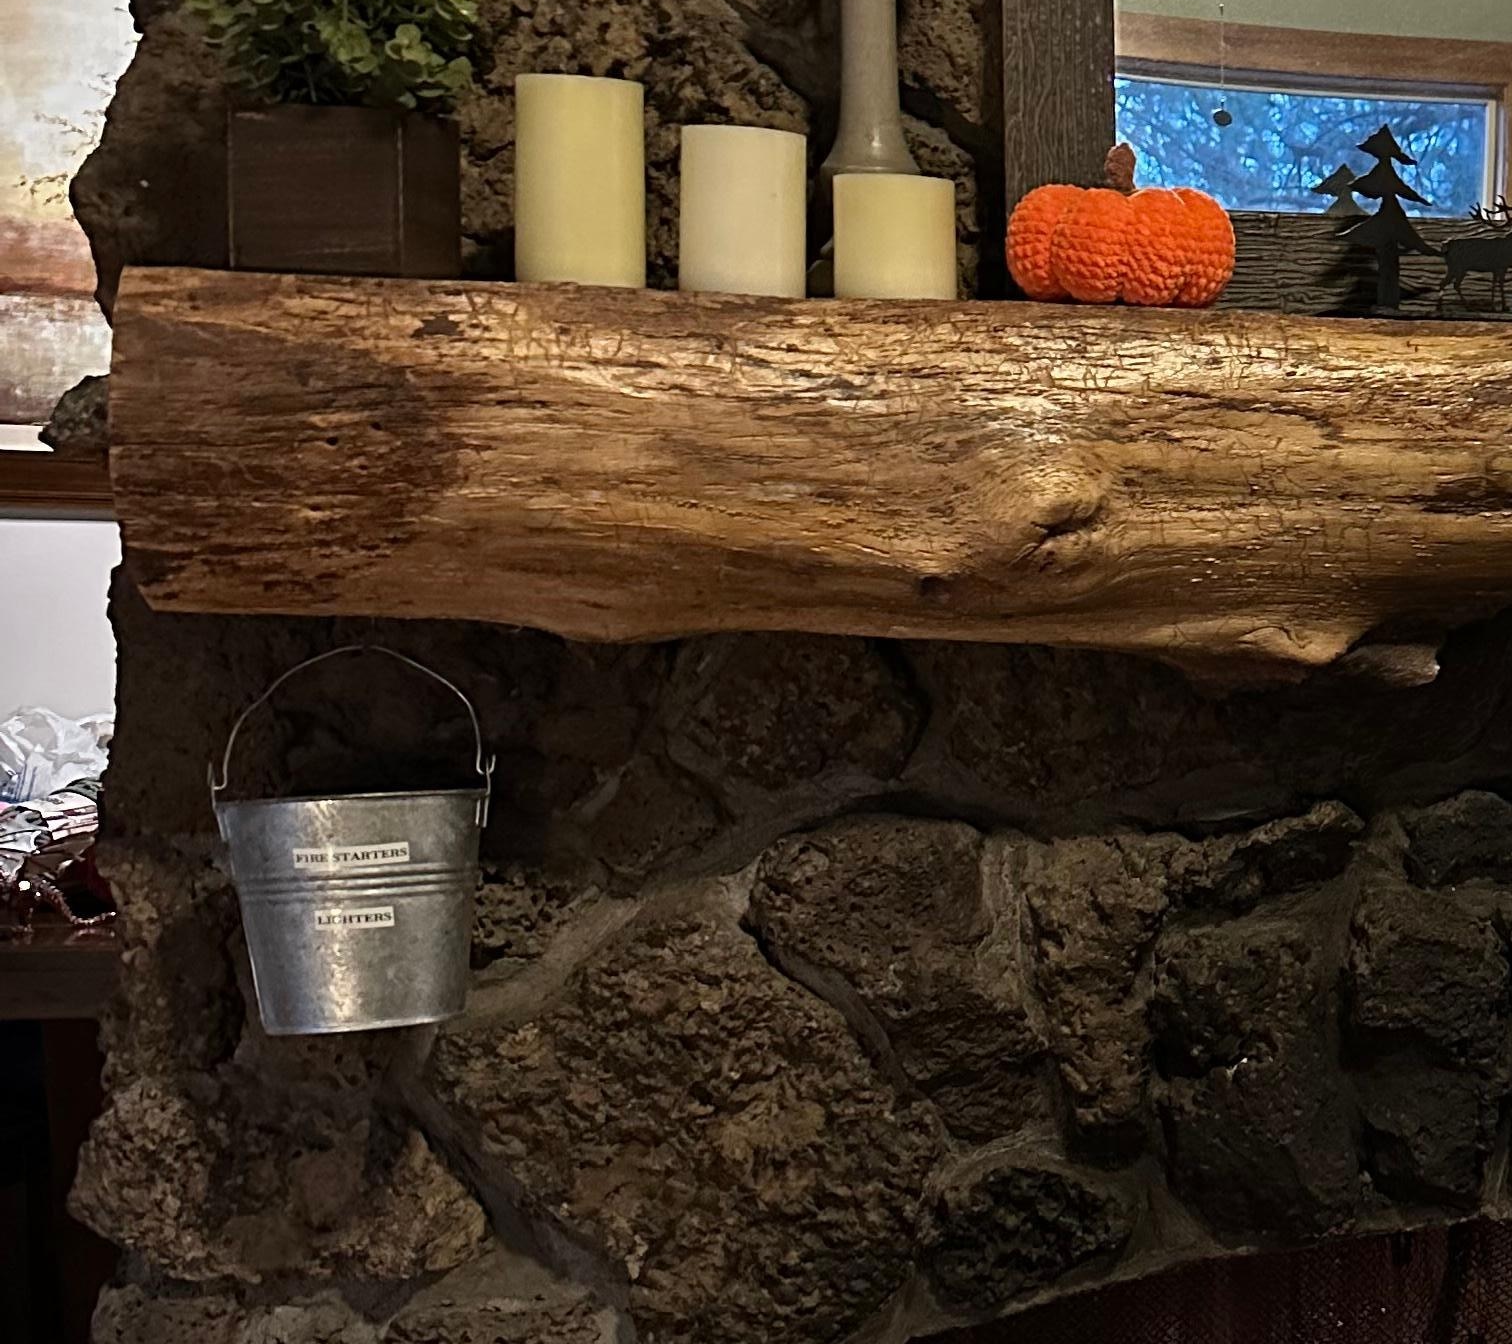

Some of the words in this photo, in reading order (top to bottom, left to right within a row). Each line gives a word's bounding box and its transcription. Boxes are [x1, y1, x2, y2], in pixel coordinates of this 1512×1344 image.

[296, 852, 329, 864] FIRE
[332, 847, 408, 863] STARTERS
[317, 912, 393, 925] LIGHTERS
